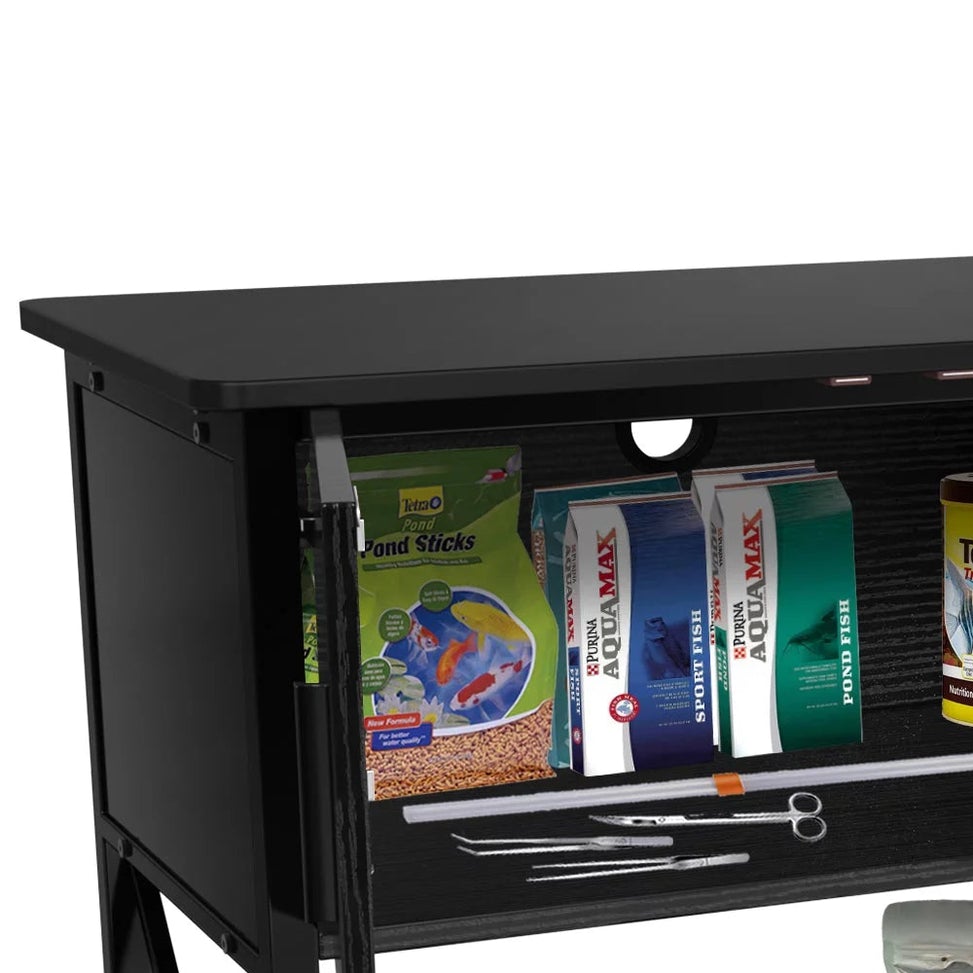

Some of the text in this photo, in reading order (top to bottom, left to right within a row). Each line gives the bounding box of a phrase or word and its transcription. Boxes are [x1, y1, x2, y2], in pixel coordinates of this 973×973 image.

[402, 517, 436, 532] Pond
[403, 499, 429, 512] Tetra
[415, 533, 477, 553] Sticks
[597, 528, 622, 680] AQUAMAX
[742, 508, 768, 663] AQUAMAX
[587, 618, 597, 663] PURINA
[733, 601, 746, 646] PURINA
[691, 609, 706, 723] SPORT FISH
[839, 599, 853, 705] POND FISH
[386, 717, 416, 726] Formula
